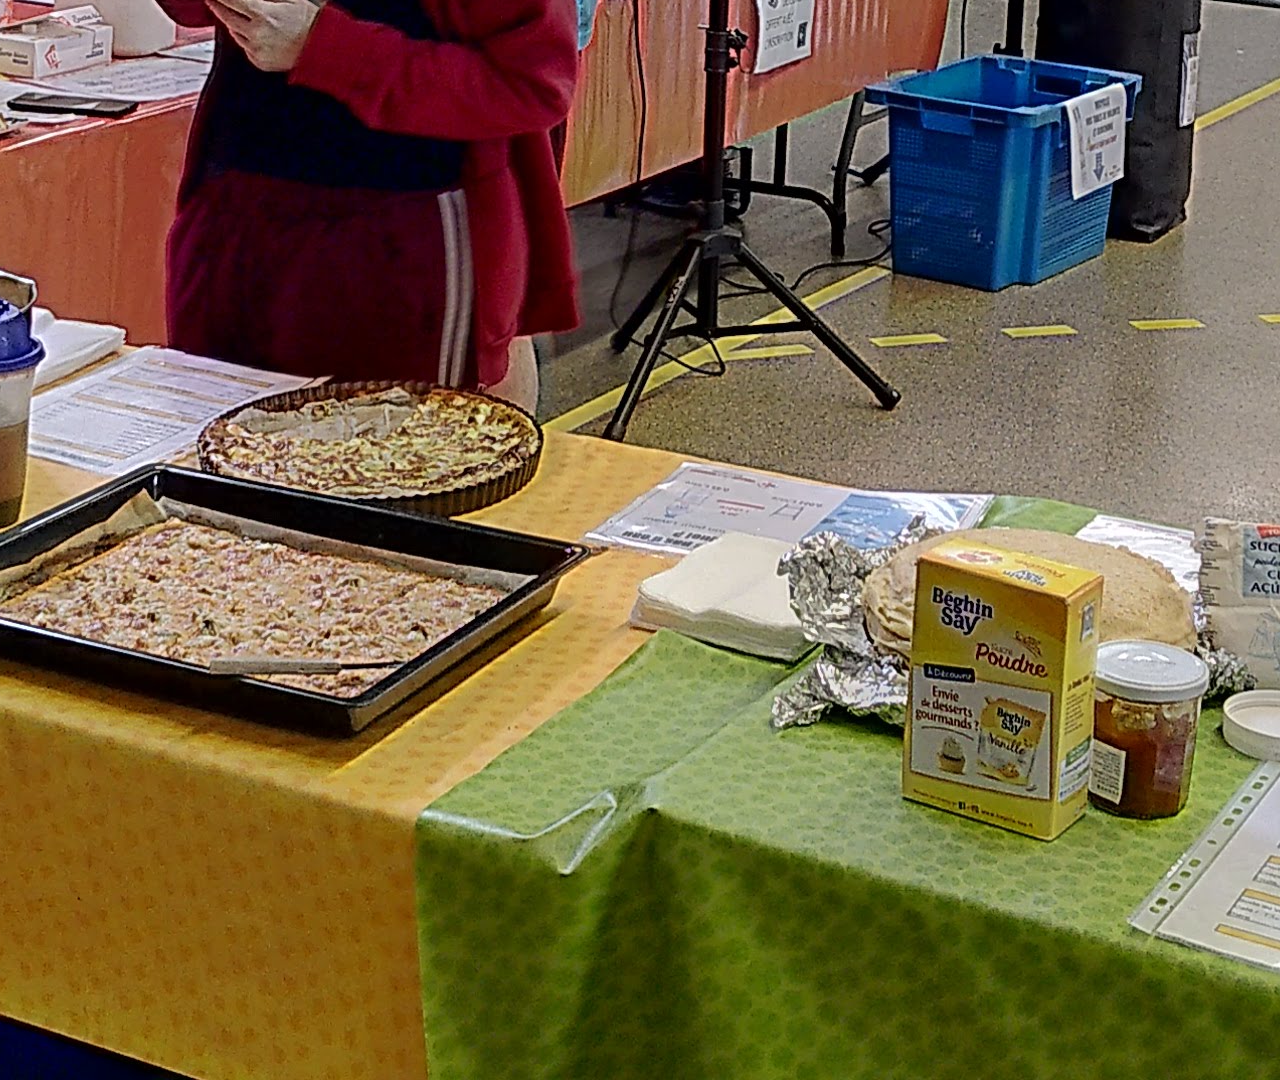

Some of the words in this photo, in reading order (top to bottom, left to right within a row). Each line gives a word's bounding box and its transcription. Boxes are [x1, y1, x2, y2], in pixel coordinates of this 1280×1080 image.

[932, 586, 993, 619] Béghin
[941, 606, 980, 635] Say
[975, 642, 1049, 678] Poudre
[932, 685, 960, 703] Envie
[915, 709, 972, 731] gourmands
[973, 720, 981, 733] ?
[921, 699, 931, 708] de
[932, 699, 973, 719] desserts
[996, 706, 1032, 728] Béghin
[1001, 719, 1024, 737] Say
[989, 732, 1027, 757] Vanille
